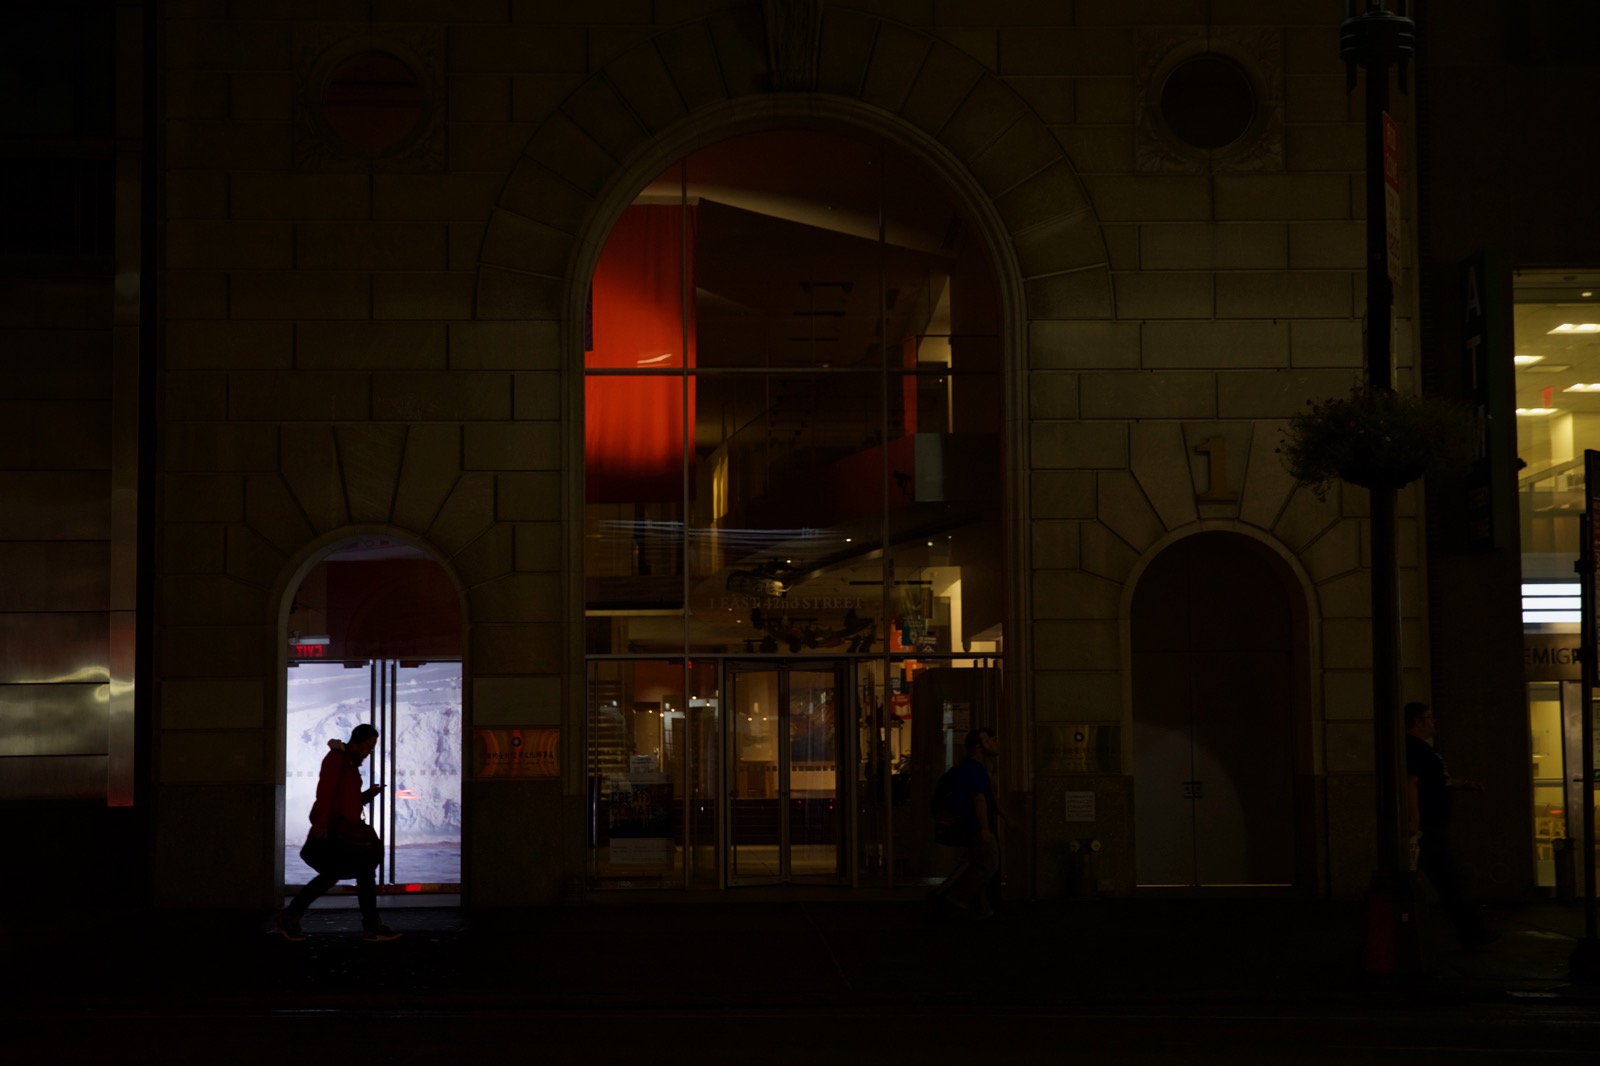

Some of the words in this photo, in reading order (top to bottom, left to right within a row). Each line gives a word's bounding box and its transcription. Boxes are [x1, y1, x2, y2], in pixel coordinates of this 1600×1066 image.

[1193, 436, 1238, 504] 1
[710, 597, 715, 609] 1
[720, 597, 761, 609] EAST
[763, 596, 799, 609] 42nd
[802, 597, 864, 609] STREET
